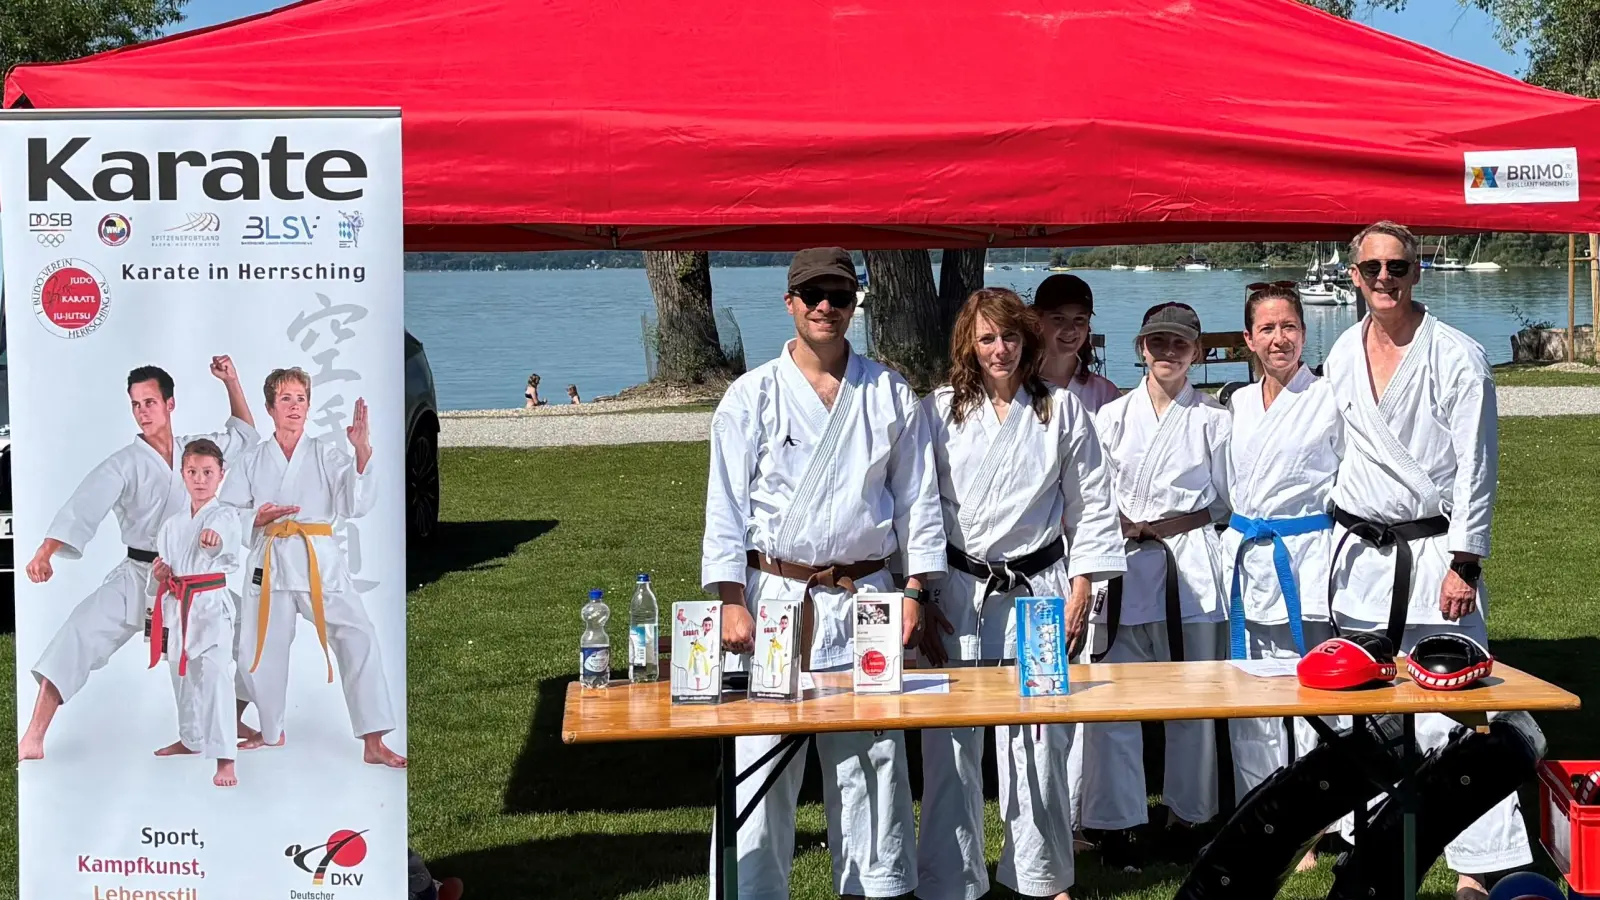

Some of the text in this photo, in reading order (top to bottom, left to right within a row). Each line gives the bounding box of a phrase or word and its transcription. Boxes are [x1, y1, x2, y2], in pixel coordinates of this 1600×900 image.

[27, 136, 368, 201] Karate
[1507, 164, 1563, 180] BRIMO
[29, 213, 72, 227] DOSB
[242, 216, 320, 240] BLSV
[70, 277, 93, 285] JUDO
[122, 263, 366, 283] Karate in Herrsching
[54, 312, 91, 321] JU-JUTSU
[141, 827, 205, 849] Sport,
[78, 855, 205, 879] Kampfkunst,
[331, 873, 364, 886] DKV
[290, 889, 335, 900] Deutscher
